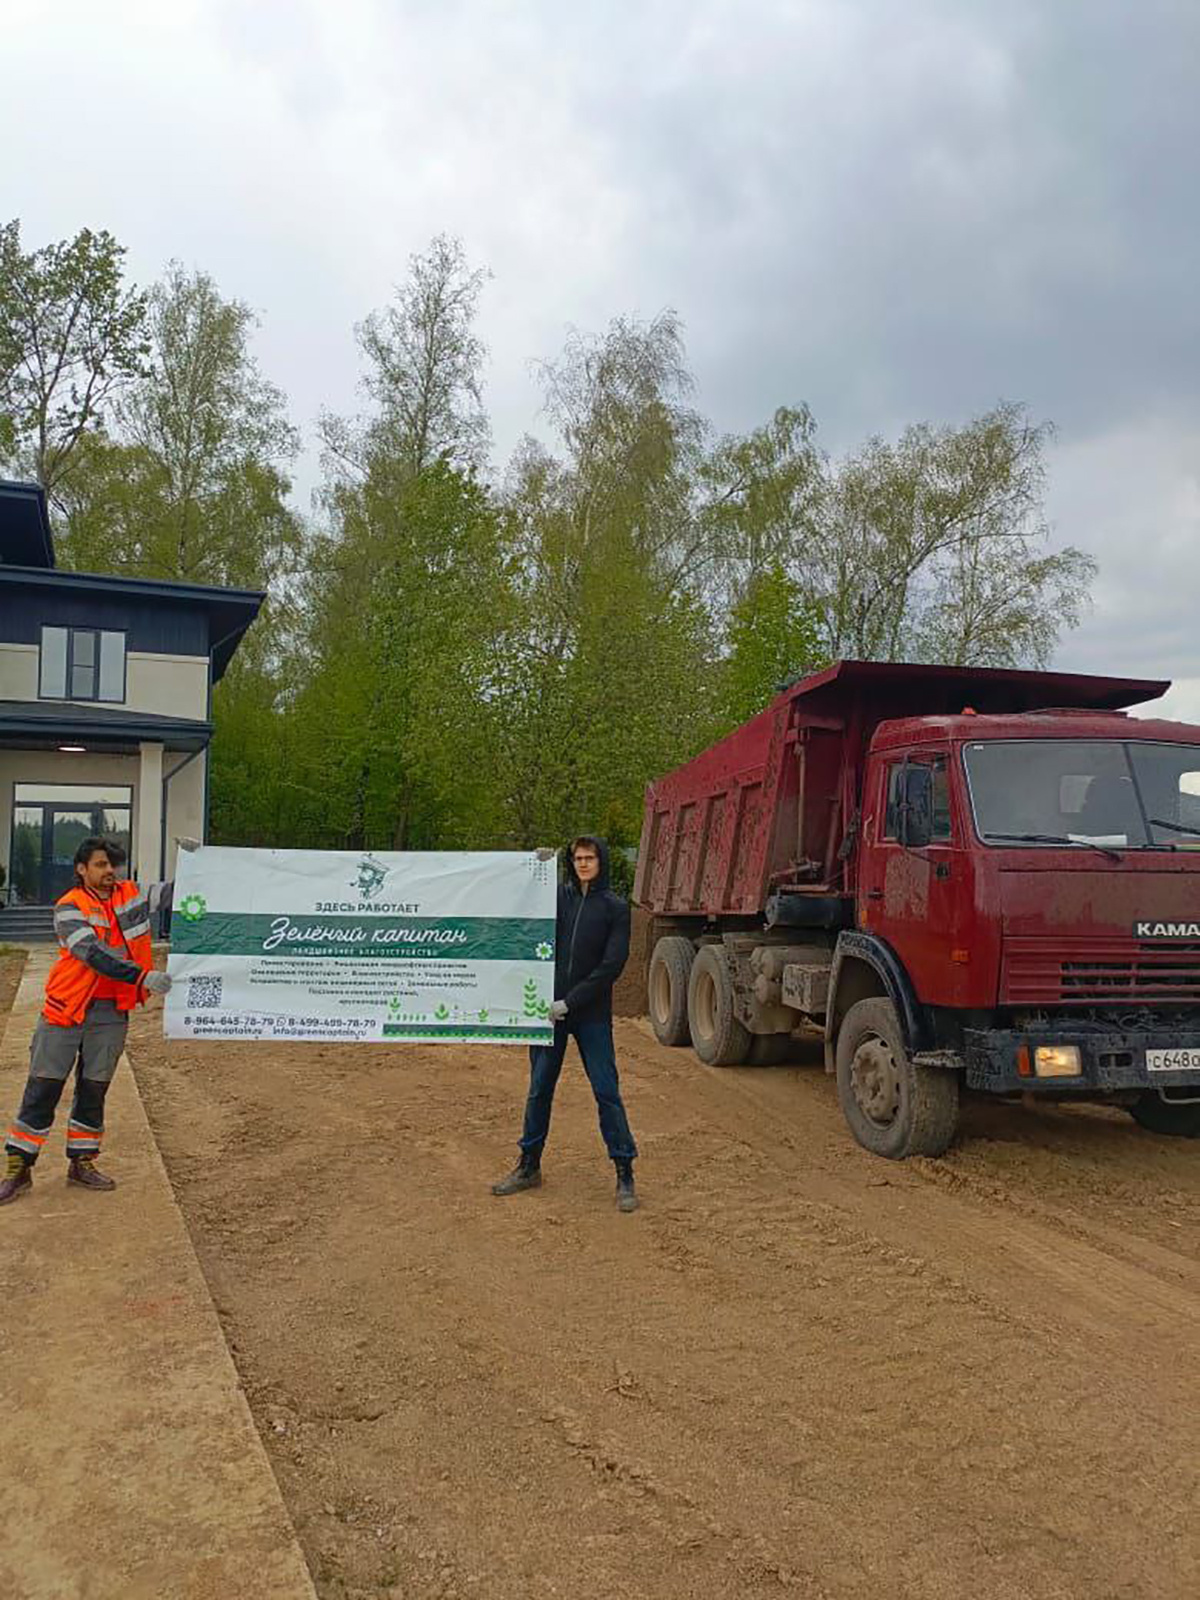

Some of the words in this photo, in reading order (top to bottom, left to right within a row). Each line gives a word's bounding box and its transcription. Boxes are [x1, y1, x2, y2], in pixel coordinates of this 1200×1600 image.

[315, 902, 355, 912] ЗДЕСЬ
[358, 903, 420, 914] РАБОТАЕТ
[262, 917, 366, 950] Зелёный
[371, 926, 468, 943] капитан
